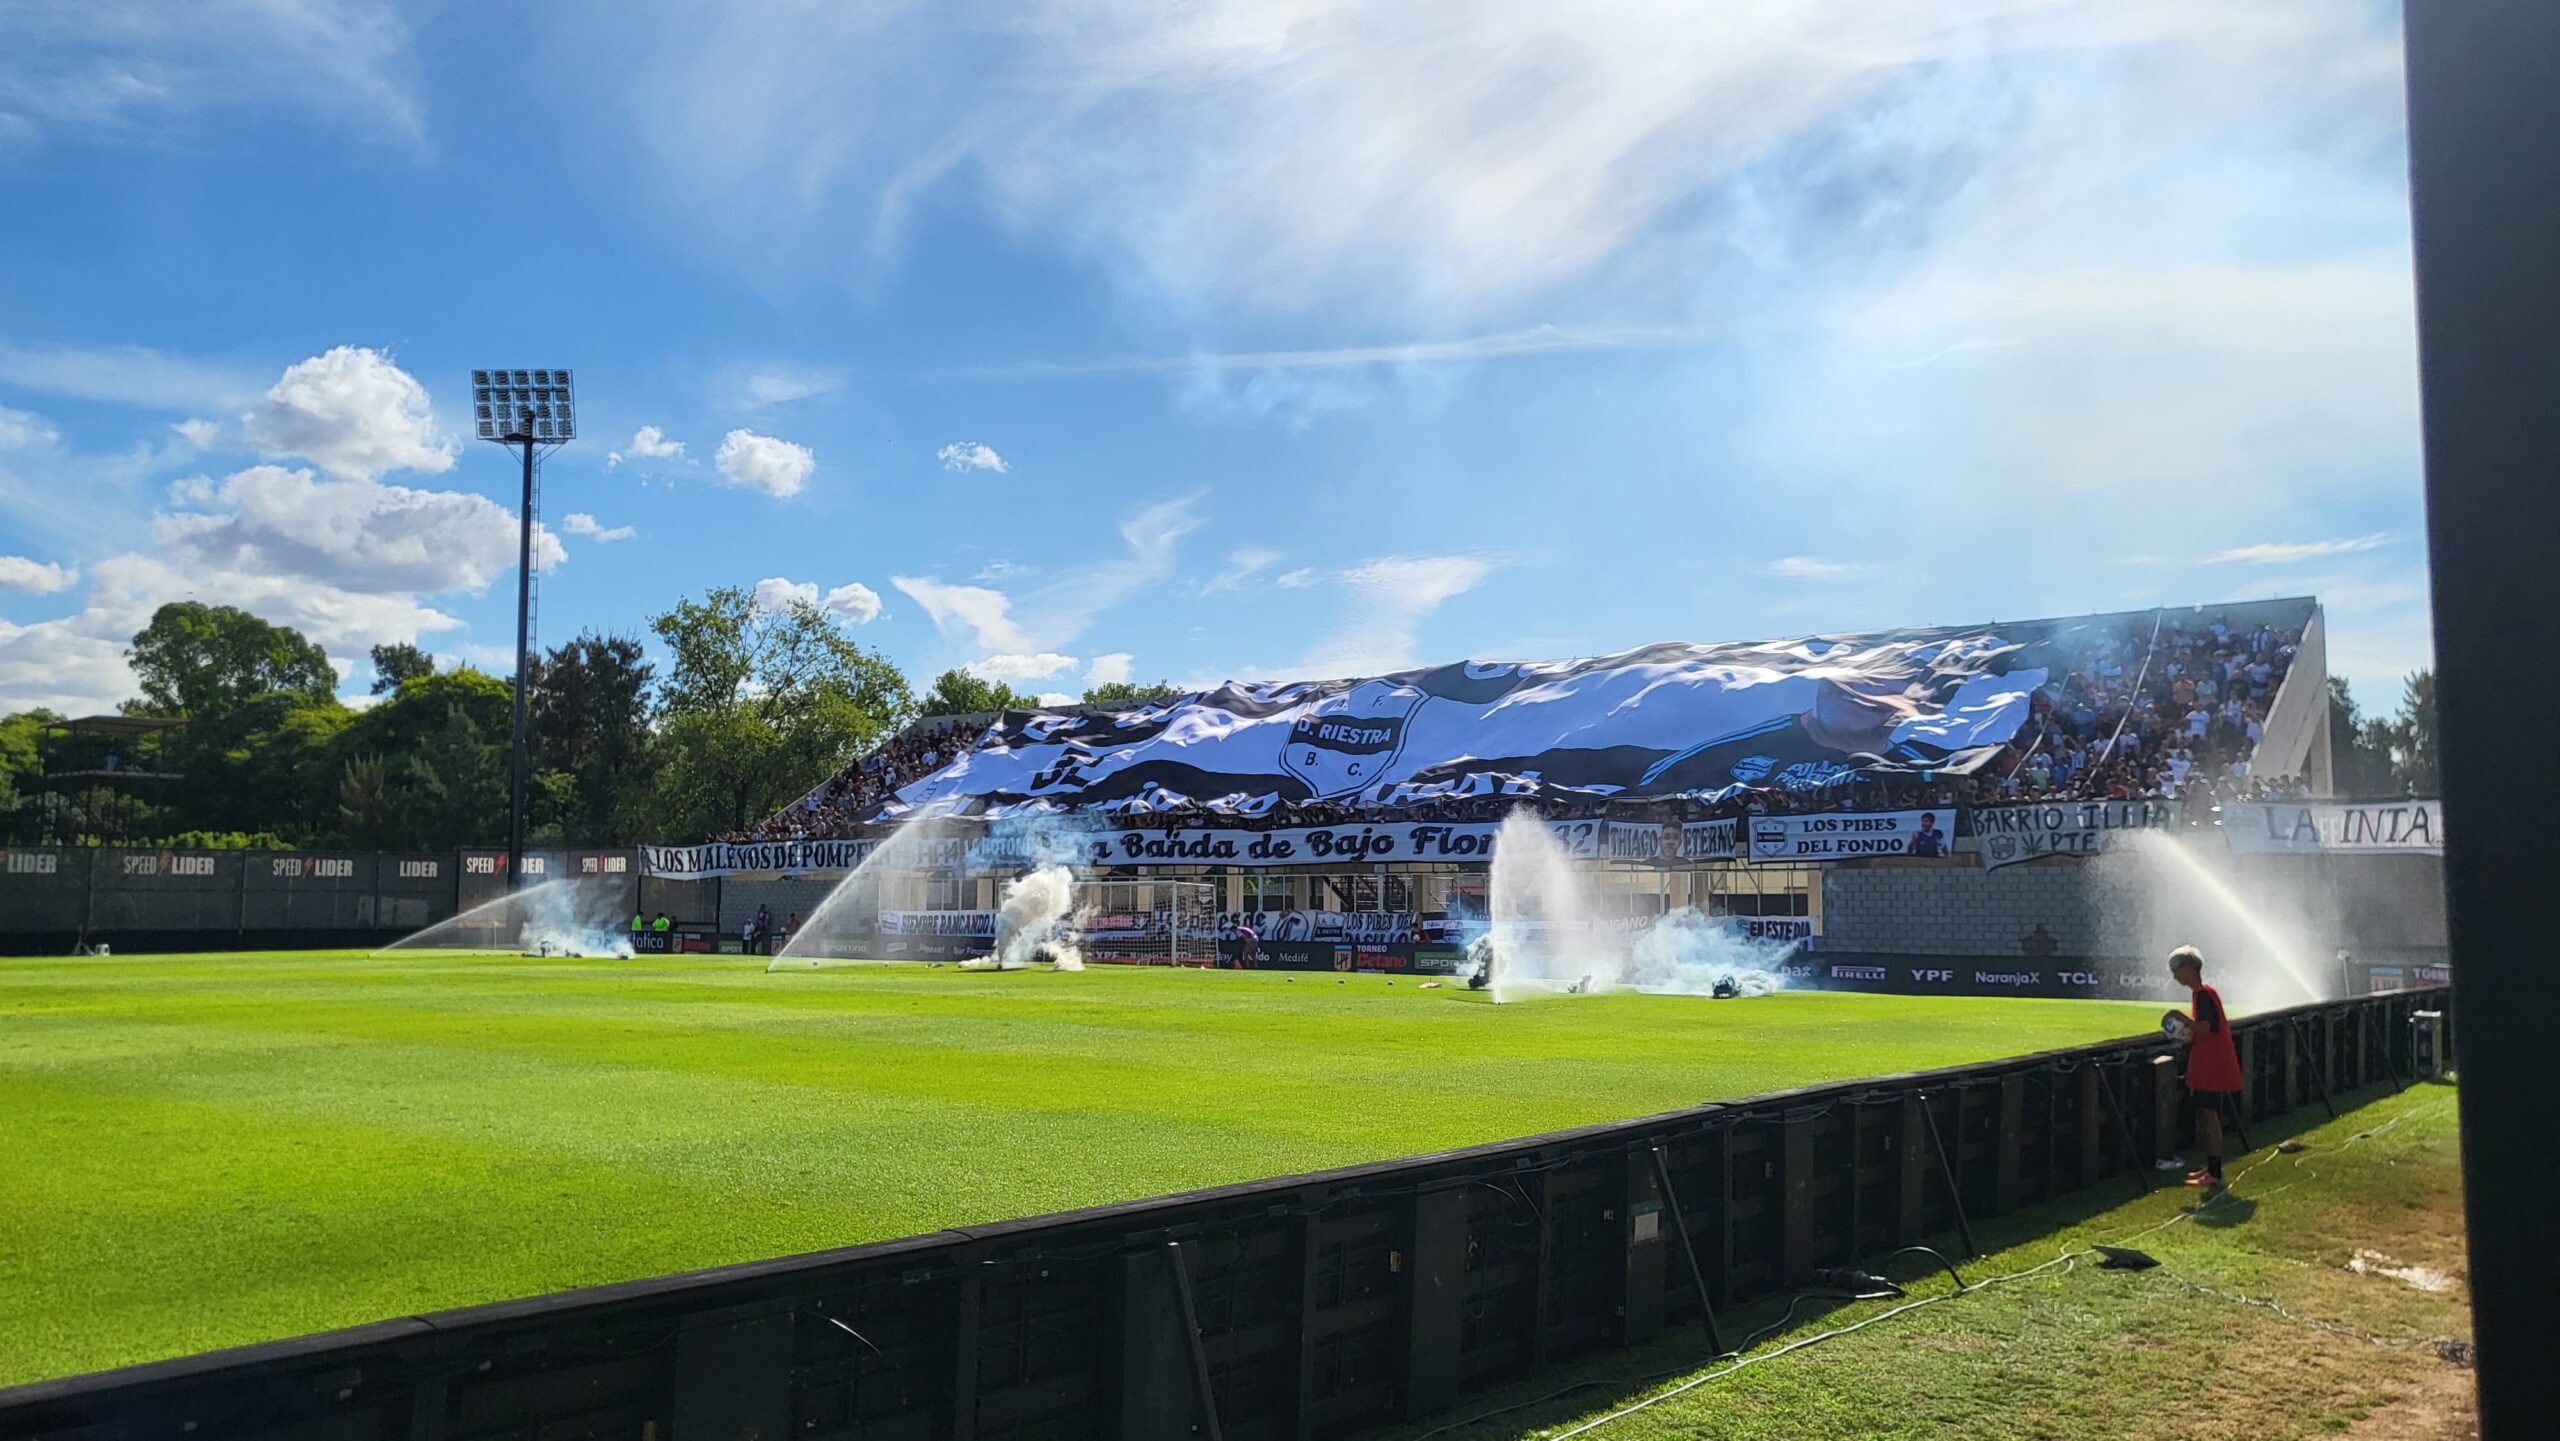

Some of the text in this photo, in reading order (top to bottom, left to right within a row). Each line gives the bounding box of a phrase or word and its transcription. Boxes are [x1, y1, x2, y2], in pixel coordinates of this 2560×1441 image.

[1319, 723, 1392, 745] RIESTRA
[1304, 751, 1362, 776] B. C.
[1802, 818, 1897, 833] LOS PIBES
[1972, 807, 2064, 837] BARRIO
[2263, 806, 2320, 842] LA
[2340, 806, 2430, 844] INTA
[1119, 833, 1240, 858] Banda
[1248, 833, 1296, 858] de
[1306, 827, 1395, 861] Bajo
[1410, 826, 1497, 856] Flor
[1610, 824, 1736, 857] THIAGO ETERNO
[1797, 838, 1903, 854] DEL FONDO
[7, 853, 57, 873] LIDER
[123, 855, 215, 875] SPEED LIDER
[466, 857, 494, 874] SPEED
[582, 856, 627, 873] SPEED LIDER
[656, 847, 684, 872] LOS
[688, 844, 771, 872] MALEVOS
[774, 844, 798, 869] DE
[272, 858, 353, 877] SPEED LIDER
[400, 861, 438, 878] LIDER
[941, 913, 989, 935] BANCANDO
[1346, 913, 1363, 930] LOS
[1366, 913, 1394, 931] PIBES
[1278, 952, 1310, 963] Medifé
[1357, 944, 1388, 953] TORNEO
[1831, 965, 1887, 980] PIRELLI
[1911, 969, 1954, 982] YPF
[1975, 971, 2040, 987] NaranjaX
[2057, 971, 2098, 985] TCL
